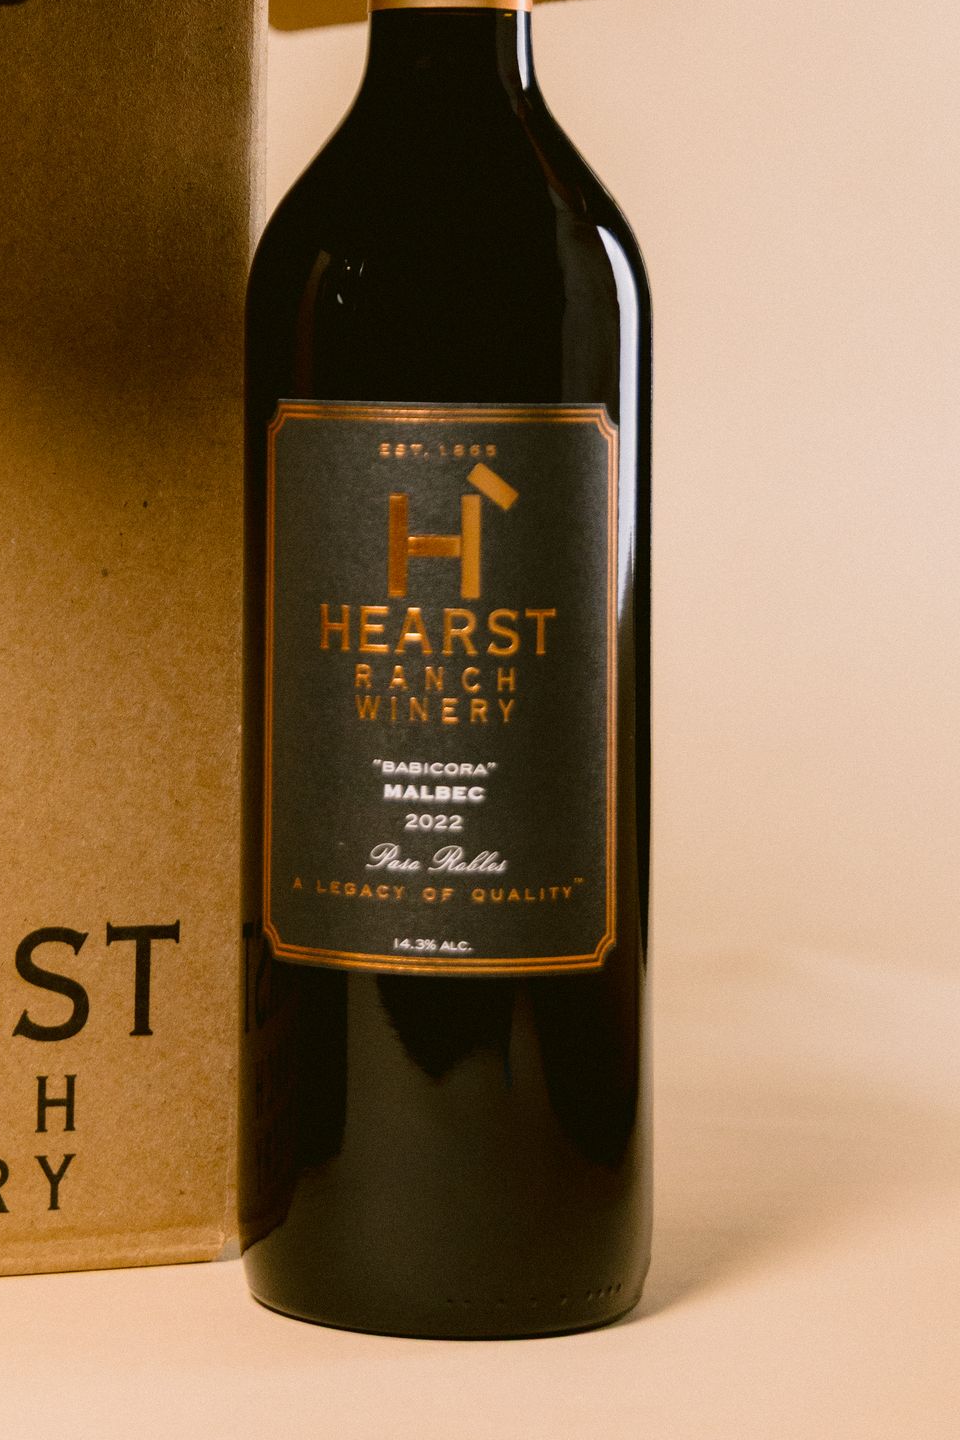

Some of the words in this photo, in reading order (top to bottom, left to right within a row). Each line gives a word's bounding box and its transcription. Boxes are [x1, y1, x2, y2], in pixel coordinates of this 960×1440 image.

[379, 442, 429, 460] EST.
[319, 603, 556, 657] HEARST
[353, 663, 517, 693] RANCH
[353, 695, 515, 726] WINERY
[383, 783, 486, 802] MALBEC
[404, 813, 464, 831] 2022
[366, 843, 422, 872] Paso
[427, 845, 508, 873] Robles
[293, 877, 304, 889] A
[317, 879, 405, 900] LEGACY
[422, 886, 456, 902] OF
[393, 938, 437, 950] 14.3%
[439, 940, 472, 951] ALC.
